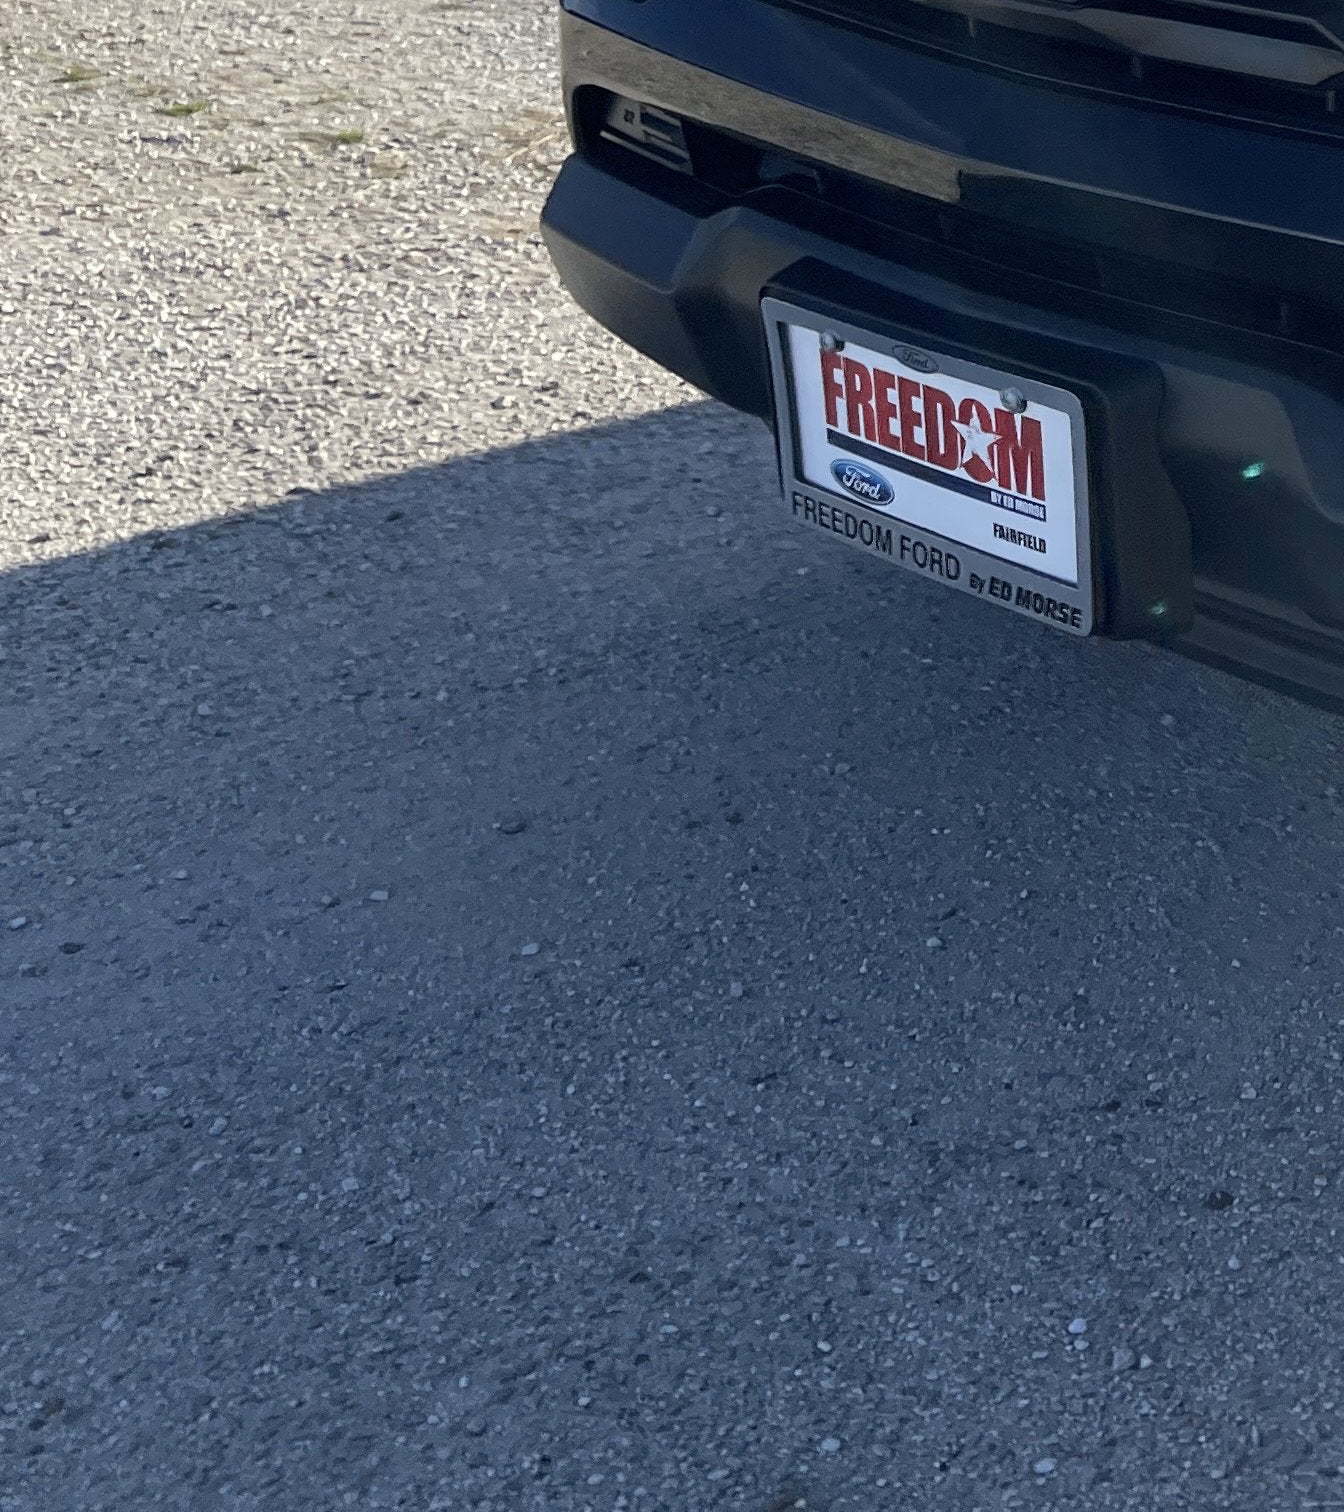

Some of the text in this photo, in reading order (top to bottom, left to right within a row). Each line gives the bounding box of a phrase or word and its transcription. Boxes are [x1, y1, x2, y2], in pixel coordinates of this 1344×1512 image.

[819, 347, 1046, 502] FREEDOM
[840, 466, 884, 502] Ford
[791, 490, 894, 556] FREEDOM
[899, 536, 962, 581] FORD
[988, 576, 1013, 602] ED
[1015, 586, 1084, 629] MORSE
[992, 522, 1047, 554] FAIRFIELD
